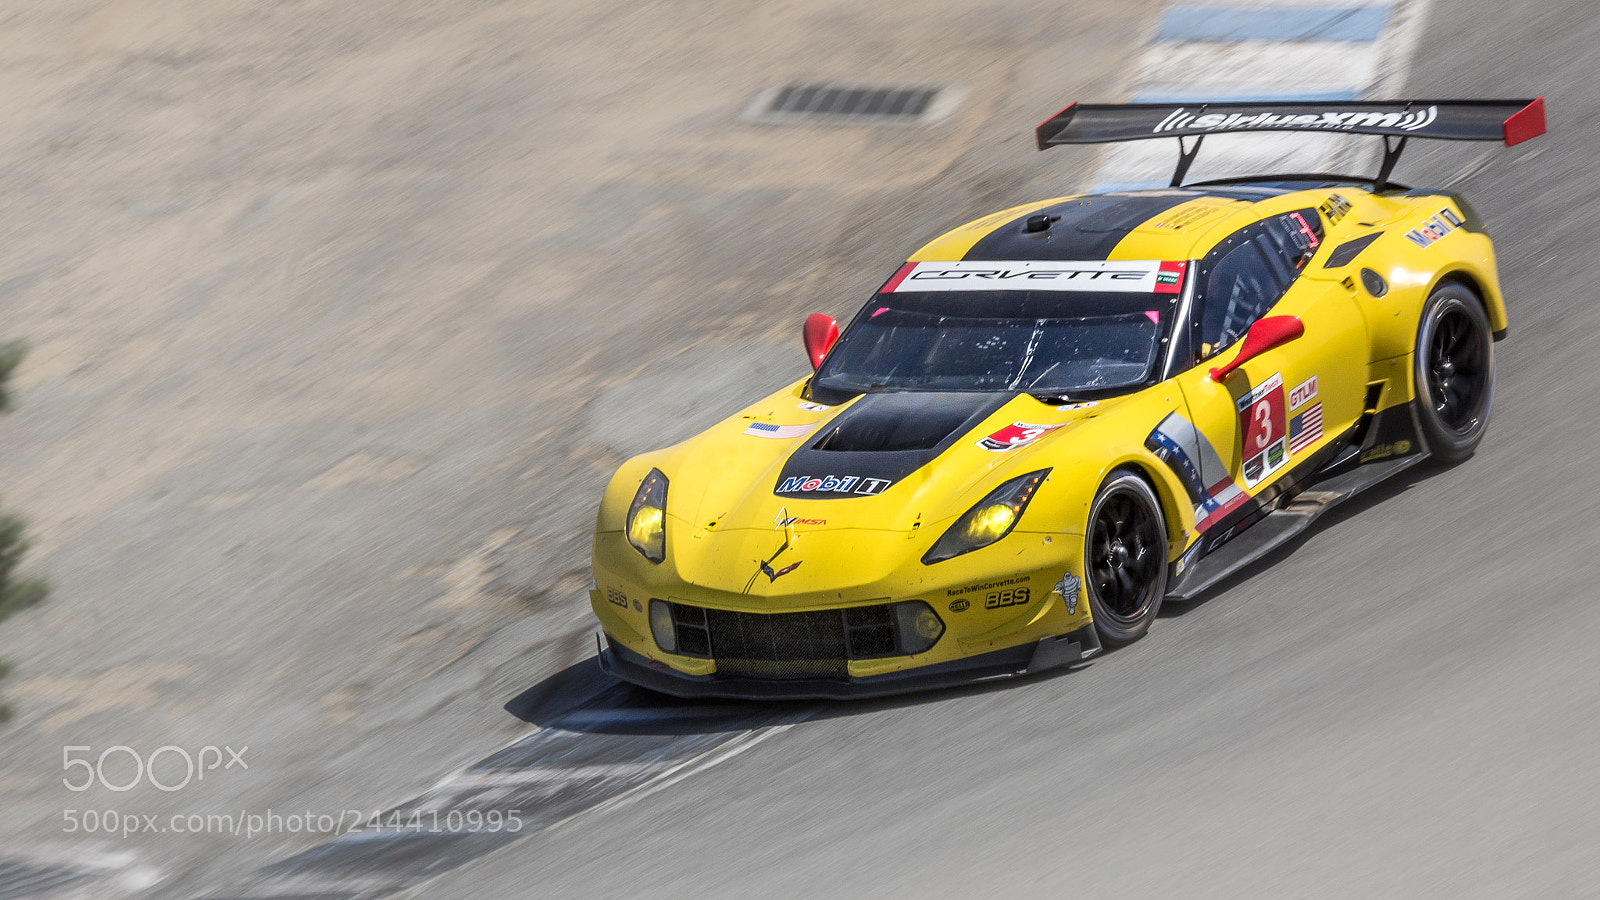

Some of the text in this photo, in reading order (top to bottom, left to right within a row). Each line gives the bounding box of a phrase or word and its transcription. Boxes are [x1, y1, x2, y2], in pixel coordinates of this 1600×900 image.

[909, 269, 1152, 281] CORVETTE
[1290, 379, 1317, 407] GTLM
[1255, 400, 1273, 449] 3
[1009, 428, 1046, 445] 3
[776, 475, 860, 493] Mobil
[794, 518, 827, 526] IMSA
[947, 575, 1031, 597] RaceToWinCorvette.com
[607, 586, 628, 609] BBS
[985, 587, 1030, 609] BBS
